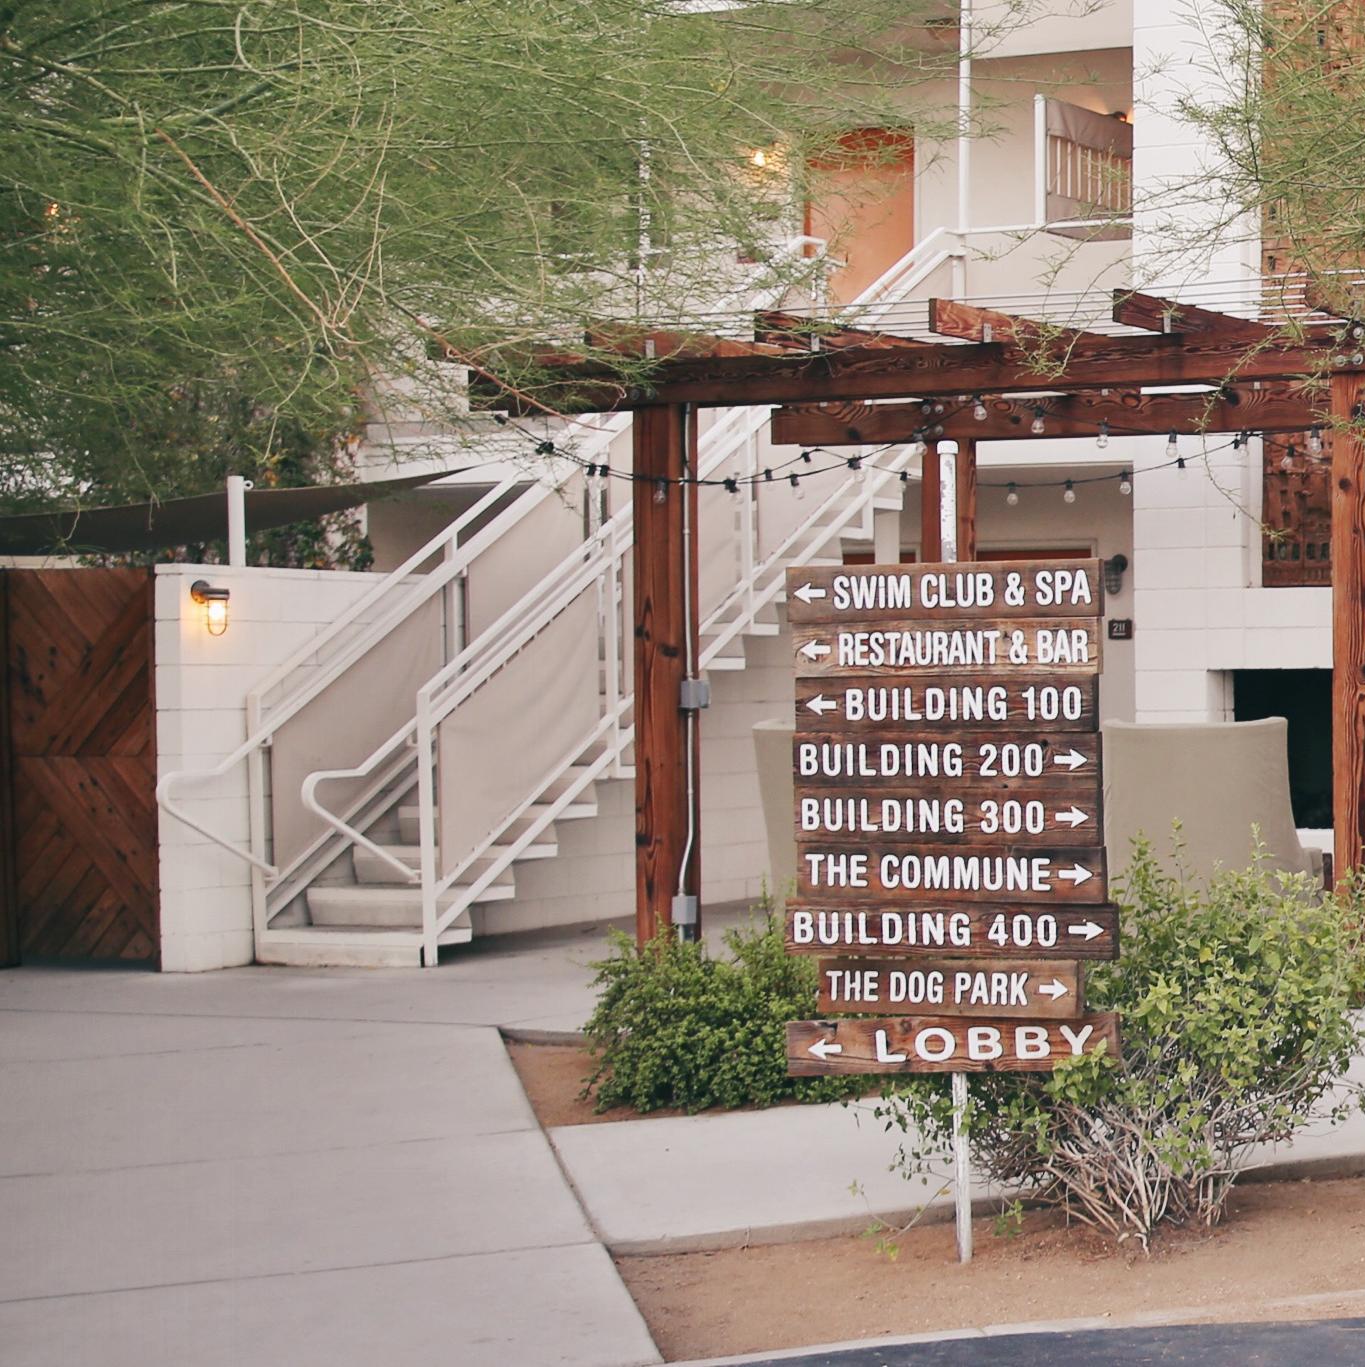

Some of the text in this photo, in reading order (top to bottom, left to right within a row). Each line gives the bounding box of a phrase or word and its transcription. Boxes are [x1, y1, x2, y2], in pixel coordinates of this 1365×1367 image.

[833, 569, 1091, 610] SWIM CLUB & SPA
[838, 629, 1089, 666] RESTAURANT & BAR
[846, 686, 1082, 721] BUILDING 100
[800, 743, 1043, 777] BUILDING 200
[801, 799, 1045, 834] BUILDING 300
[805, 854, 1051, 891] THE COMMUNE
[793, 912, 1057, 947] BUILDING 400
[826, 970, 1029, 1006] THE DOG PARK
[875, 1025, 1093, 1063] LOBBY
